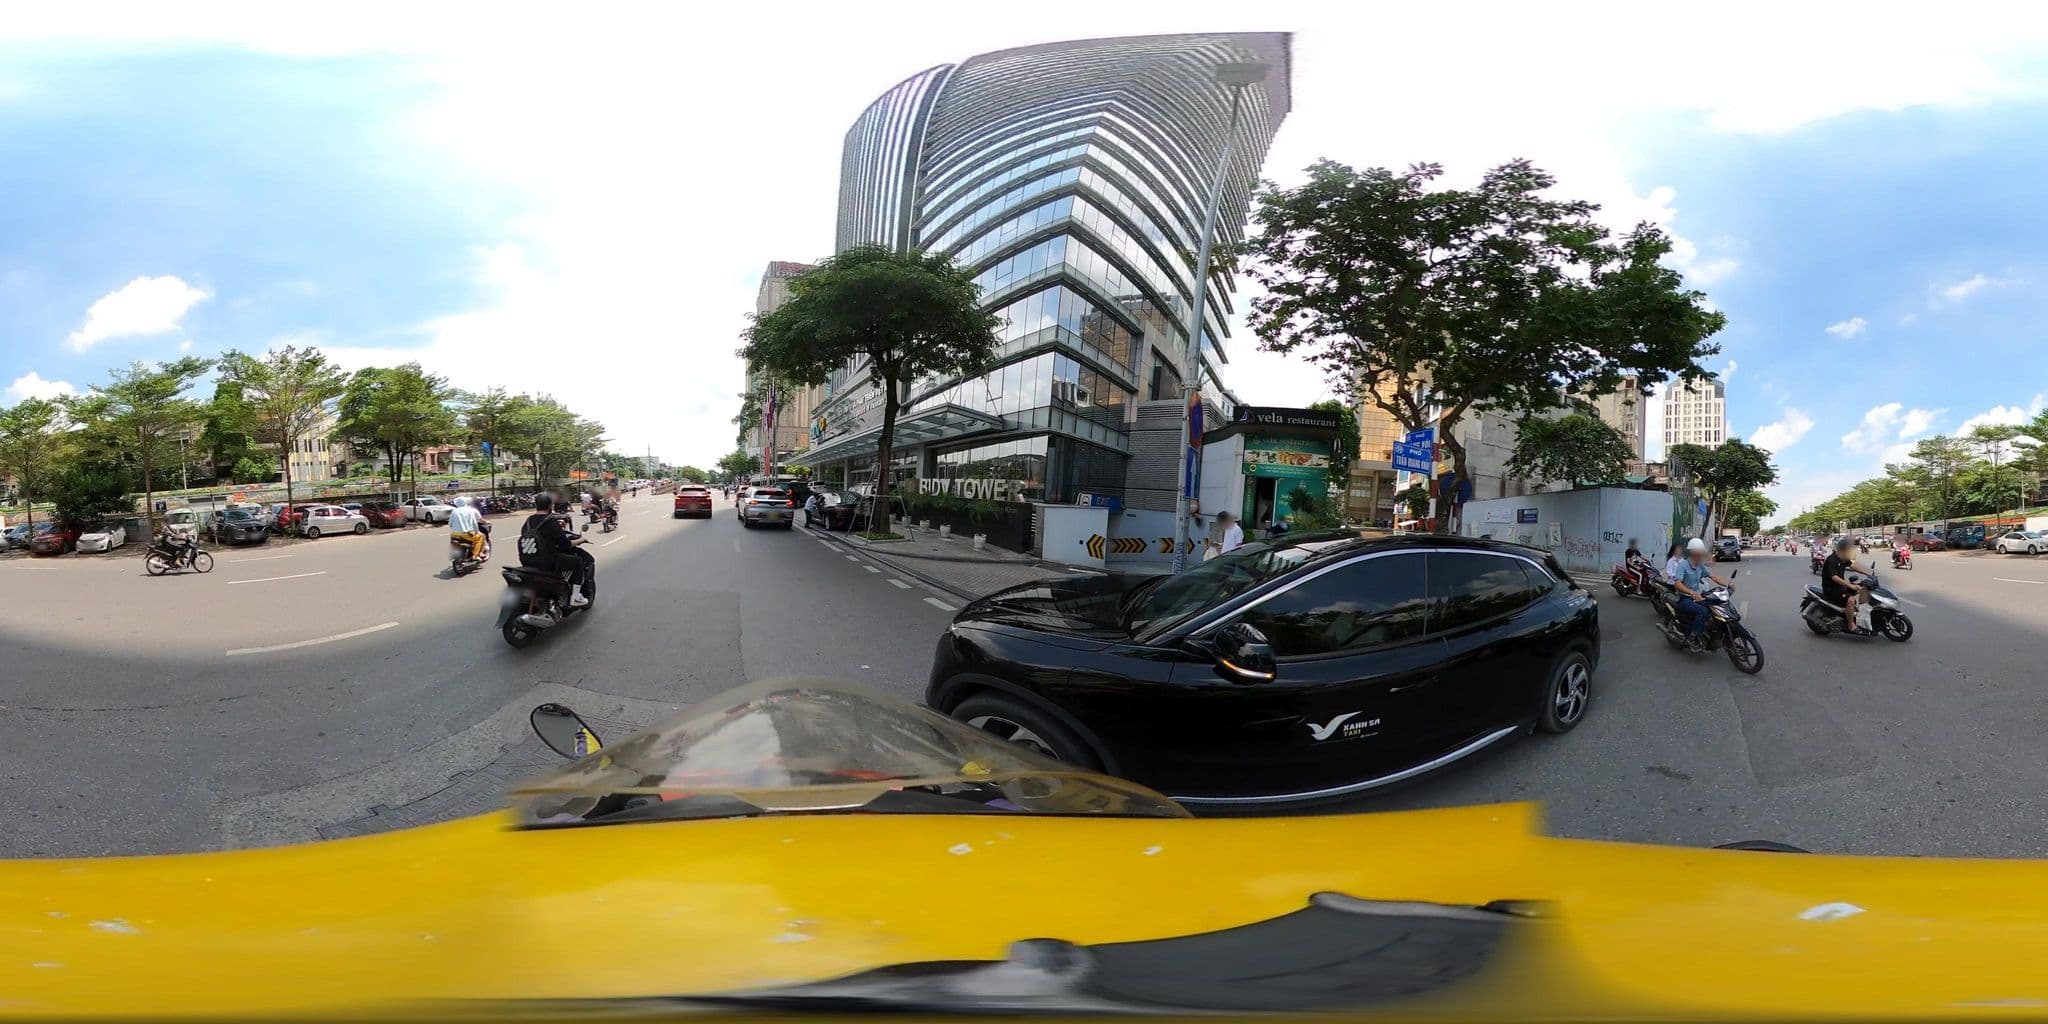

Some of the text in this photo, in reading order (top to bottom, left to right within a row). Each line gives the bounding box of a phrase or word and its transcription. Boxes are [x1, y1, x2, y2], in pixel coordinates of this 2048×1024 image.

[1257, 412, 1336, 427] vela restaurant
[954, 478, 1024, 503] TOWER
[1344, 729, 1361, 737] TAXI
